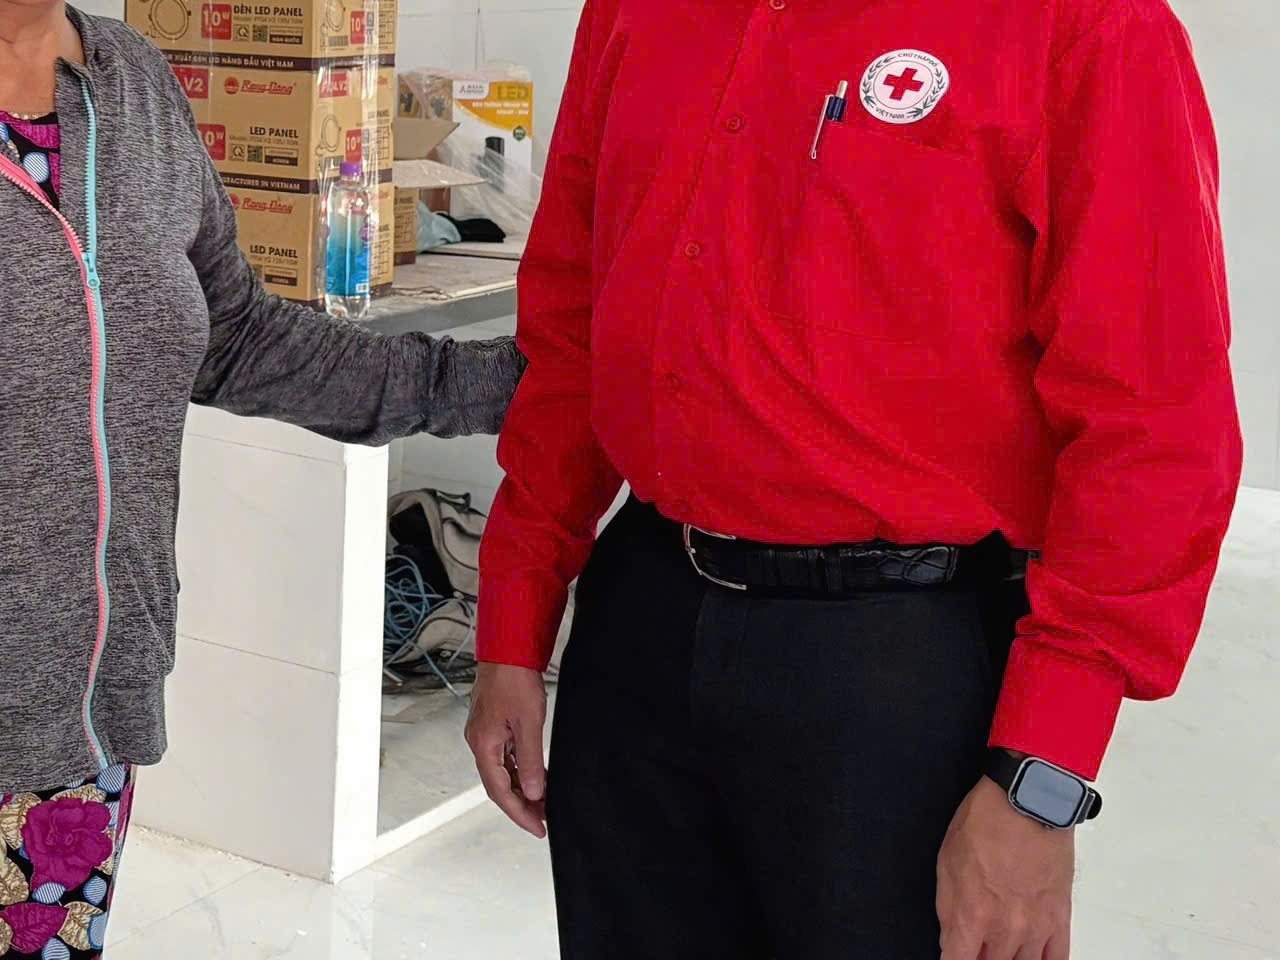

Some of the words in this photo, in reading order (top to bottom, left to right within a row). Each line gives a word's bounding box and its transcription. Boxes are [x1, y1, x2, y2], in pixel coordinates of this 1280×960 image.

[233, 2, 252, 15] ĐÈN
[254, 5, 271, 16] LED
[273, 6, 304, 18] PANEL
[276, 60, 294, 68] NAM
[497, 85, 529, 101] LED
[249, 125, 266, 136] LED
[269, 127, 299, 139] PANEL
[222, 176, 260, 186] UFACTURER
[270, 180, 300, 190] VIETNAM
[250, 244, 266, 255] LED
[268, 246, 298, 259] PANEL
